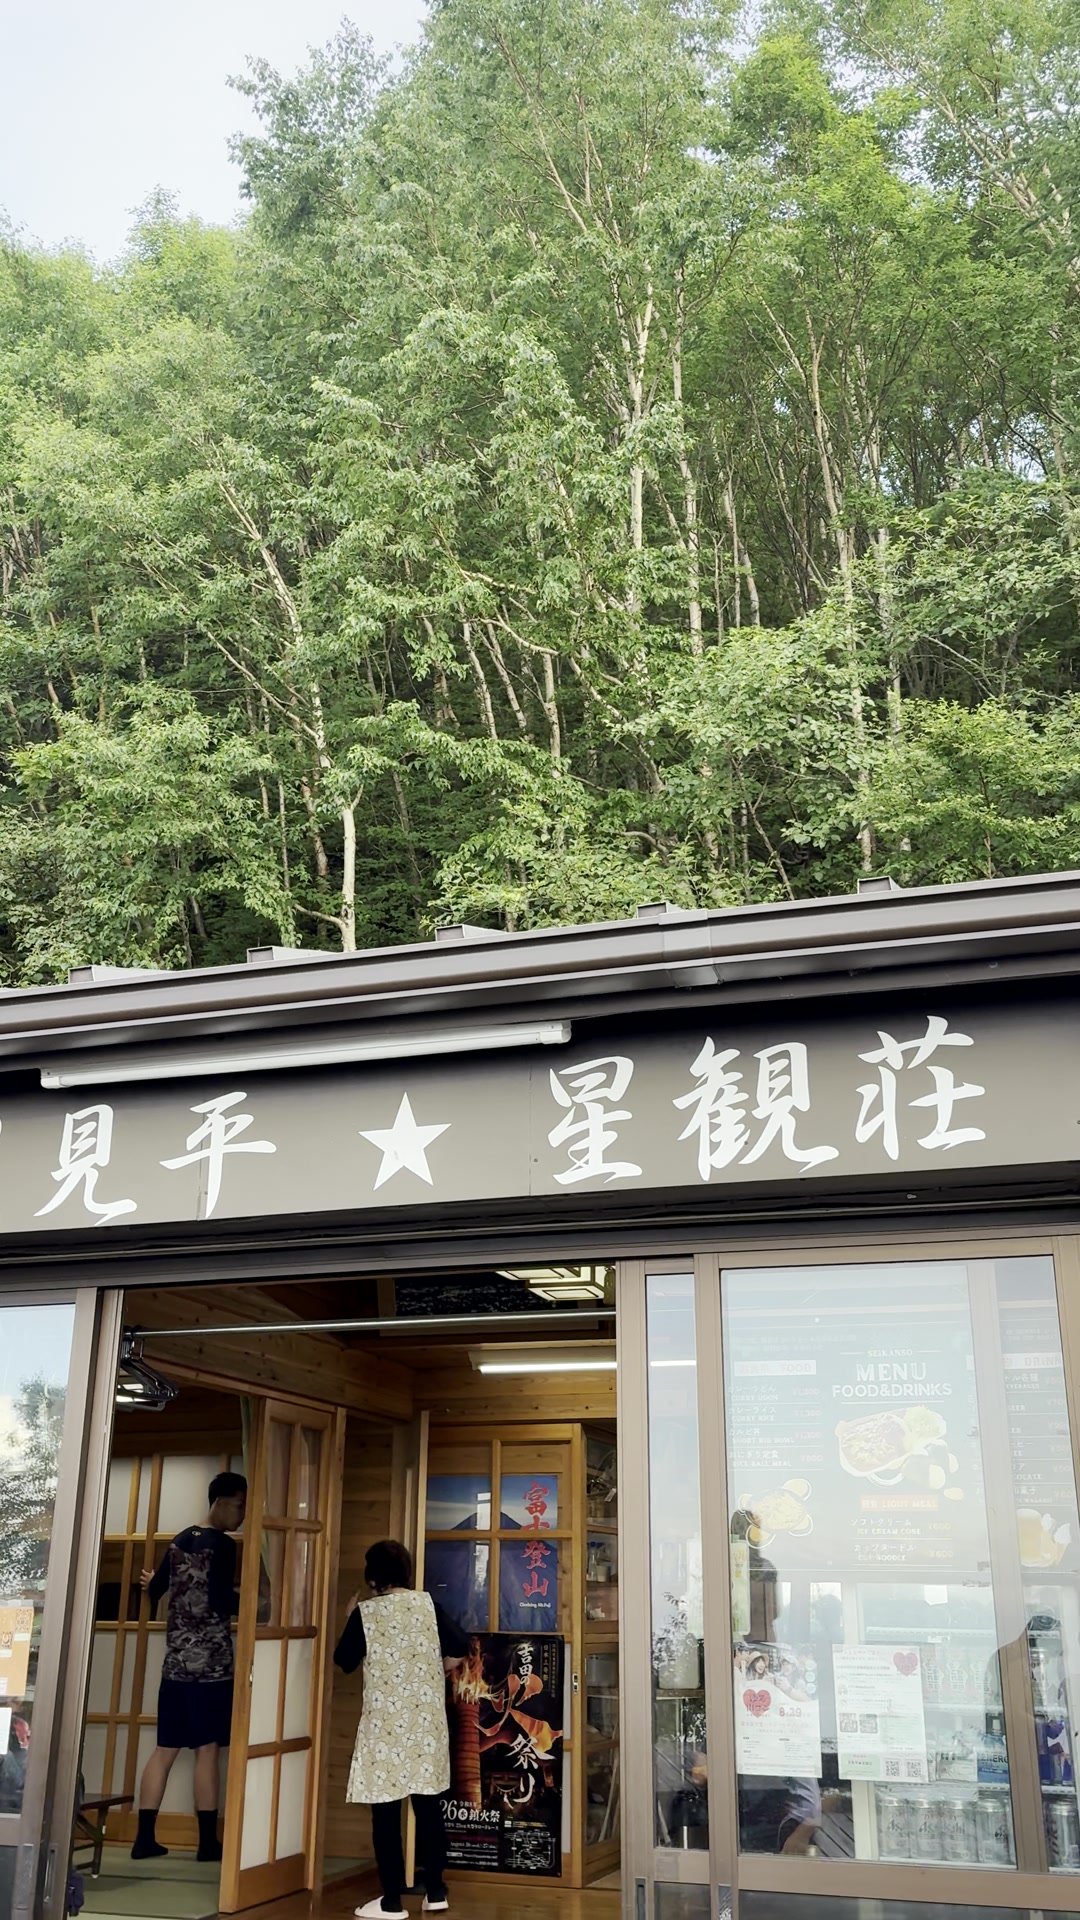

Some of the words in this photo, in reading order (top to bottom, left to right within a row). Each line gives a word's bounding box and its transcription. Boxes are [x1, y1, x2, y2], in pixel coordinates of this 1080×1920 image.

[0, 1091, 275, 1226] 見平
[547, 1015, 986, 1185] 星観荘
[867, 1349, 913, 1357] SEIKANSO
[856, 1362, 927, 1381] MENU
[832, 1383, 952, 1398] FOOD&DRINKS
